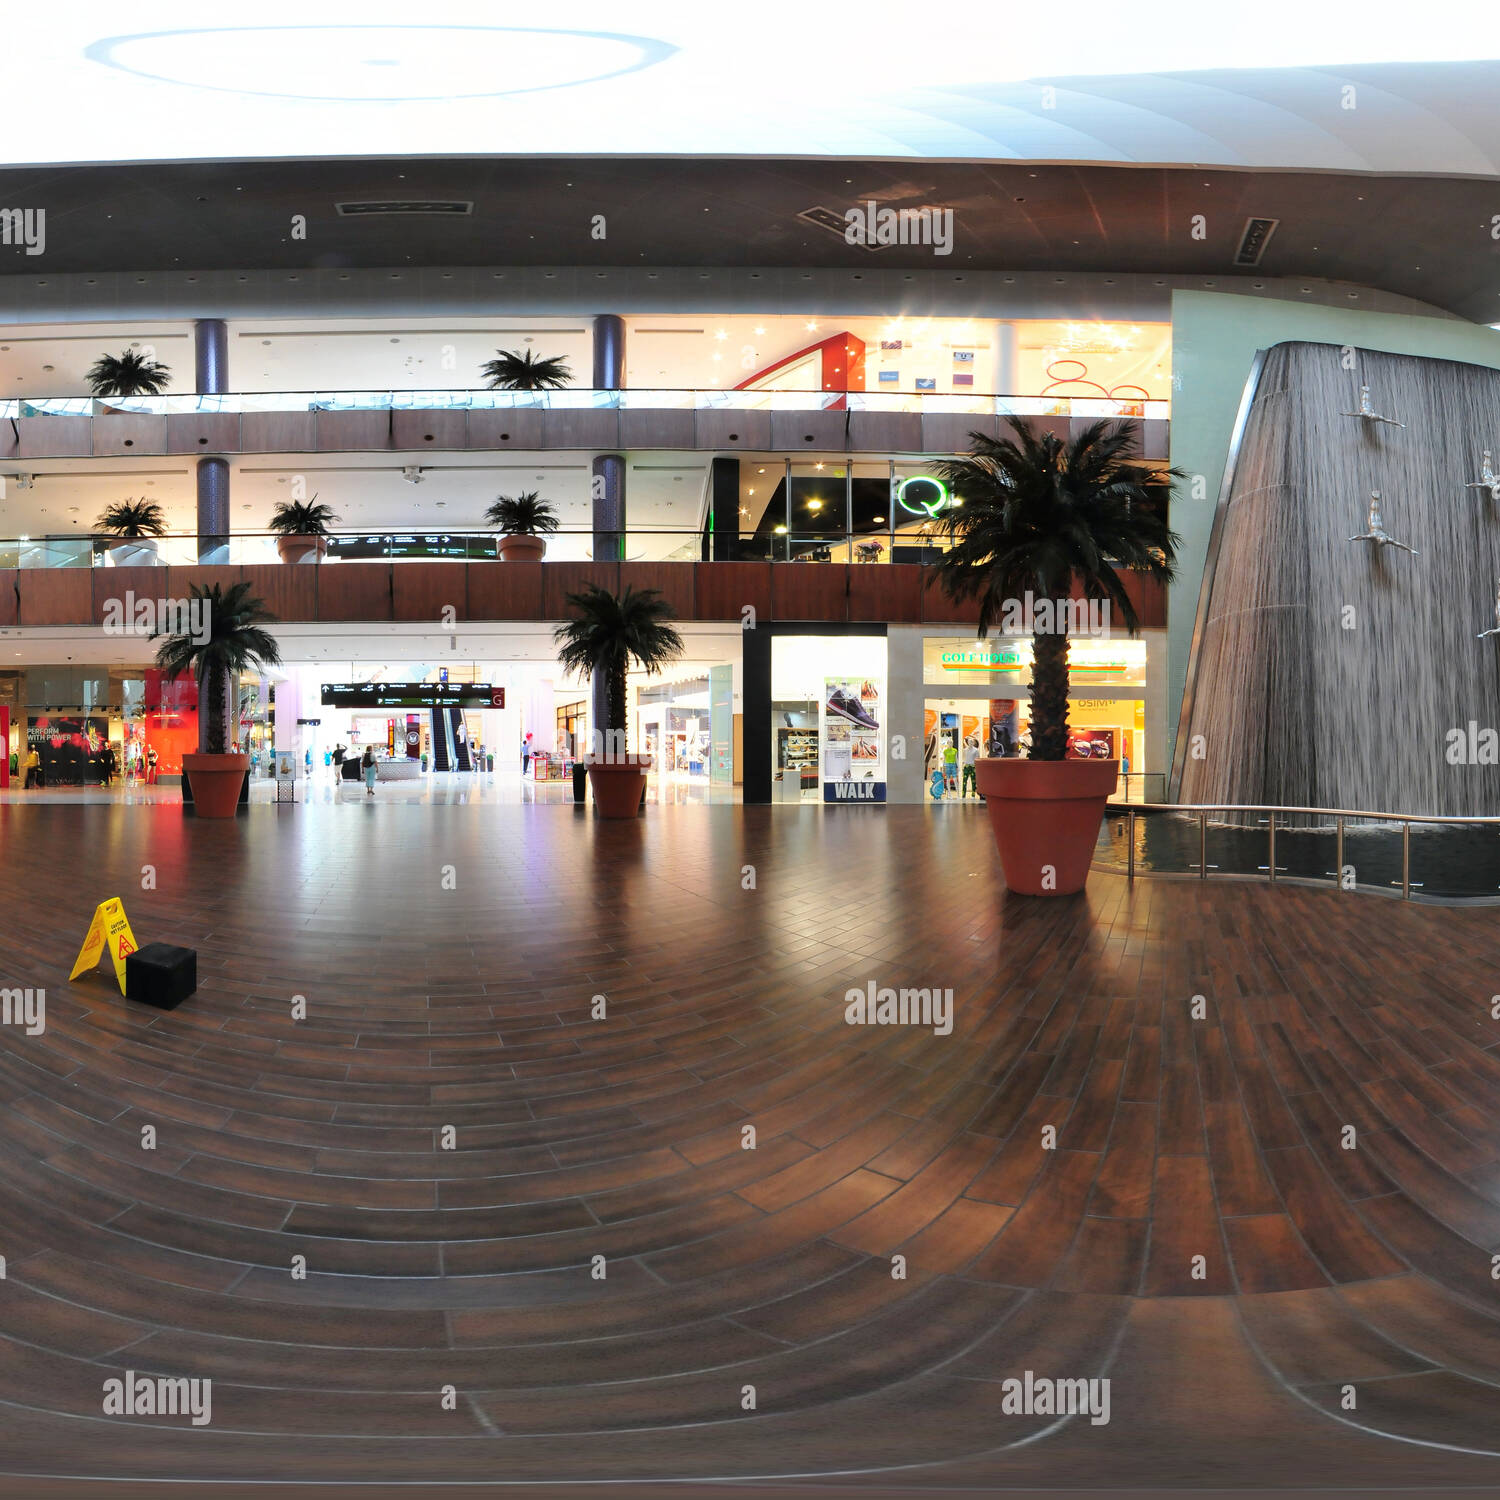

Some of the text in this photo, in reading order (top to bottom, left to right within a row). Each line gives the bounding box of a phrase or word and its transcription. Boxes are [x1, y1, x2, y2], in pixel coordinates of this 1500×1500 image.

[897, 475, 947, 519] Q
[941, 652, 977, 664] GOLF
[492, 695, 502, 706] G
[834, 782, 875, 799] WALK
